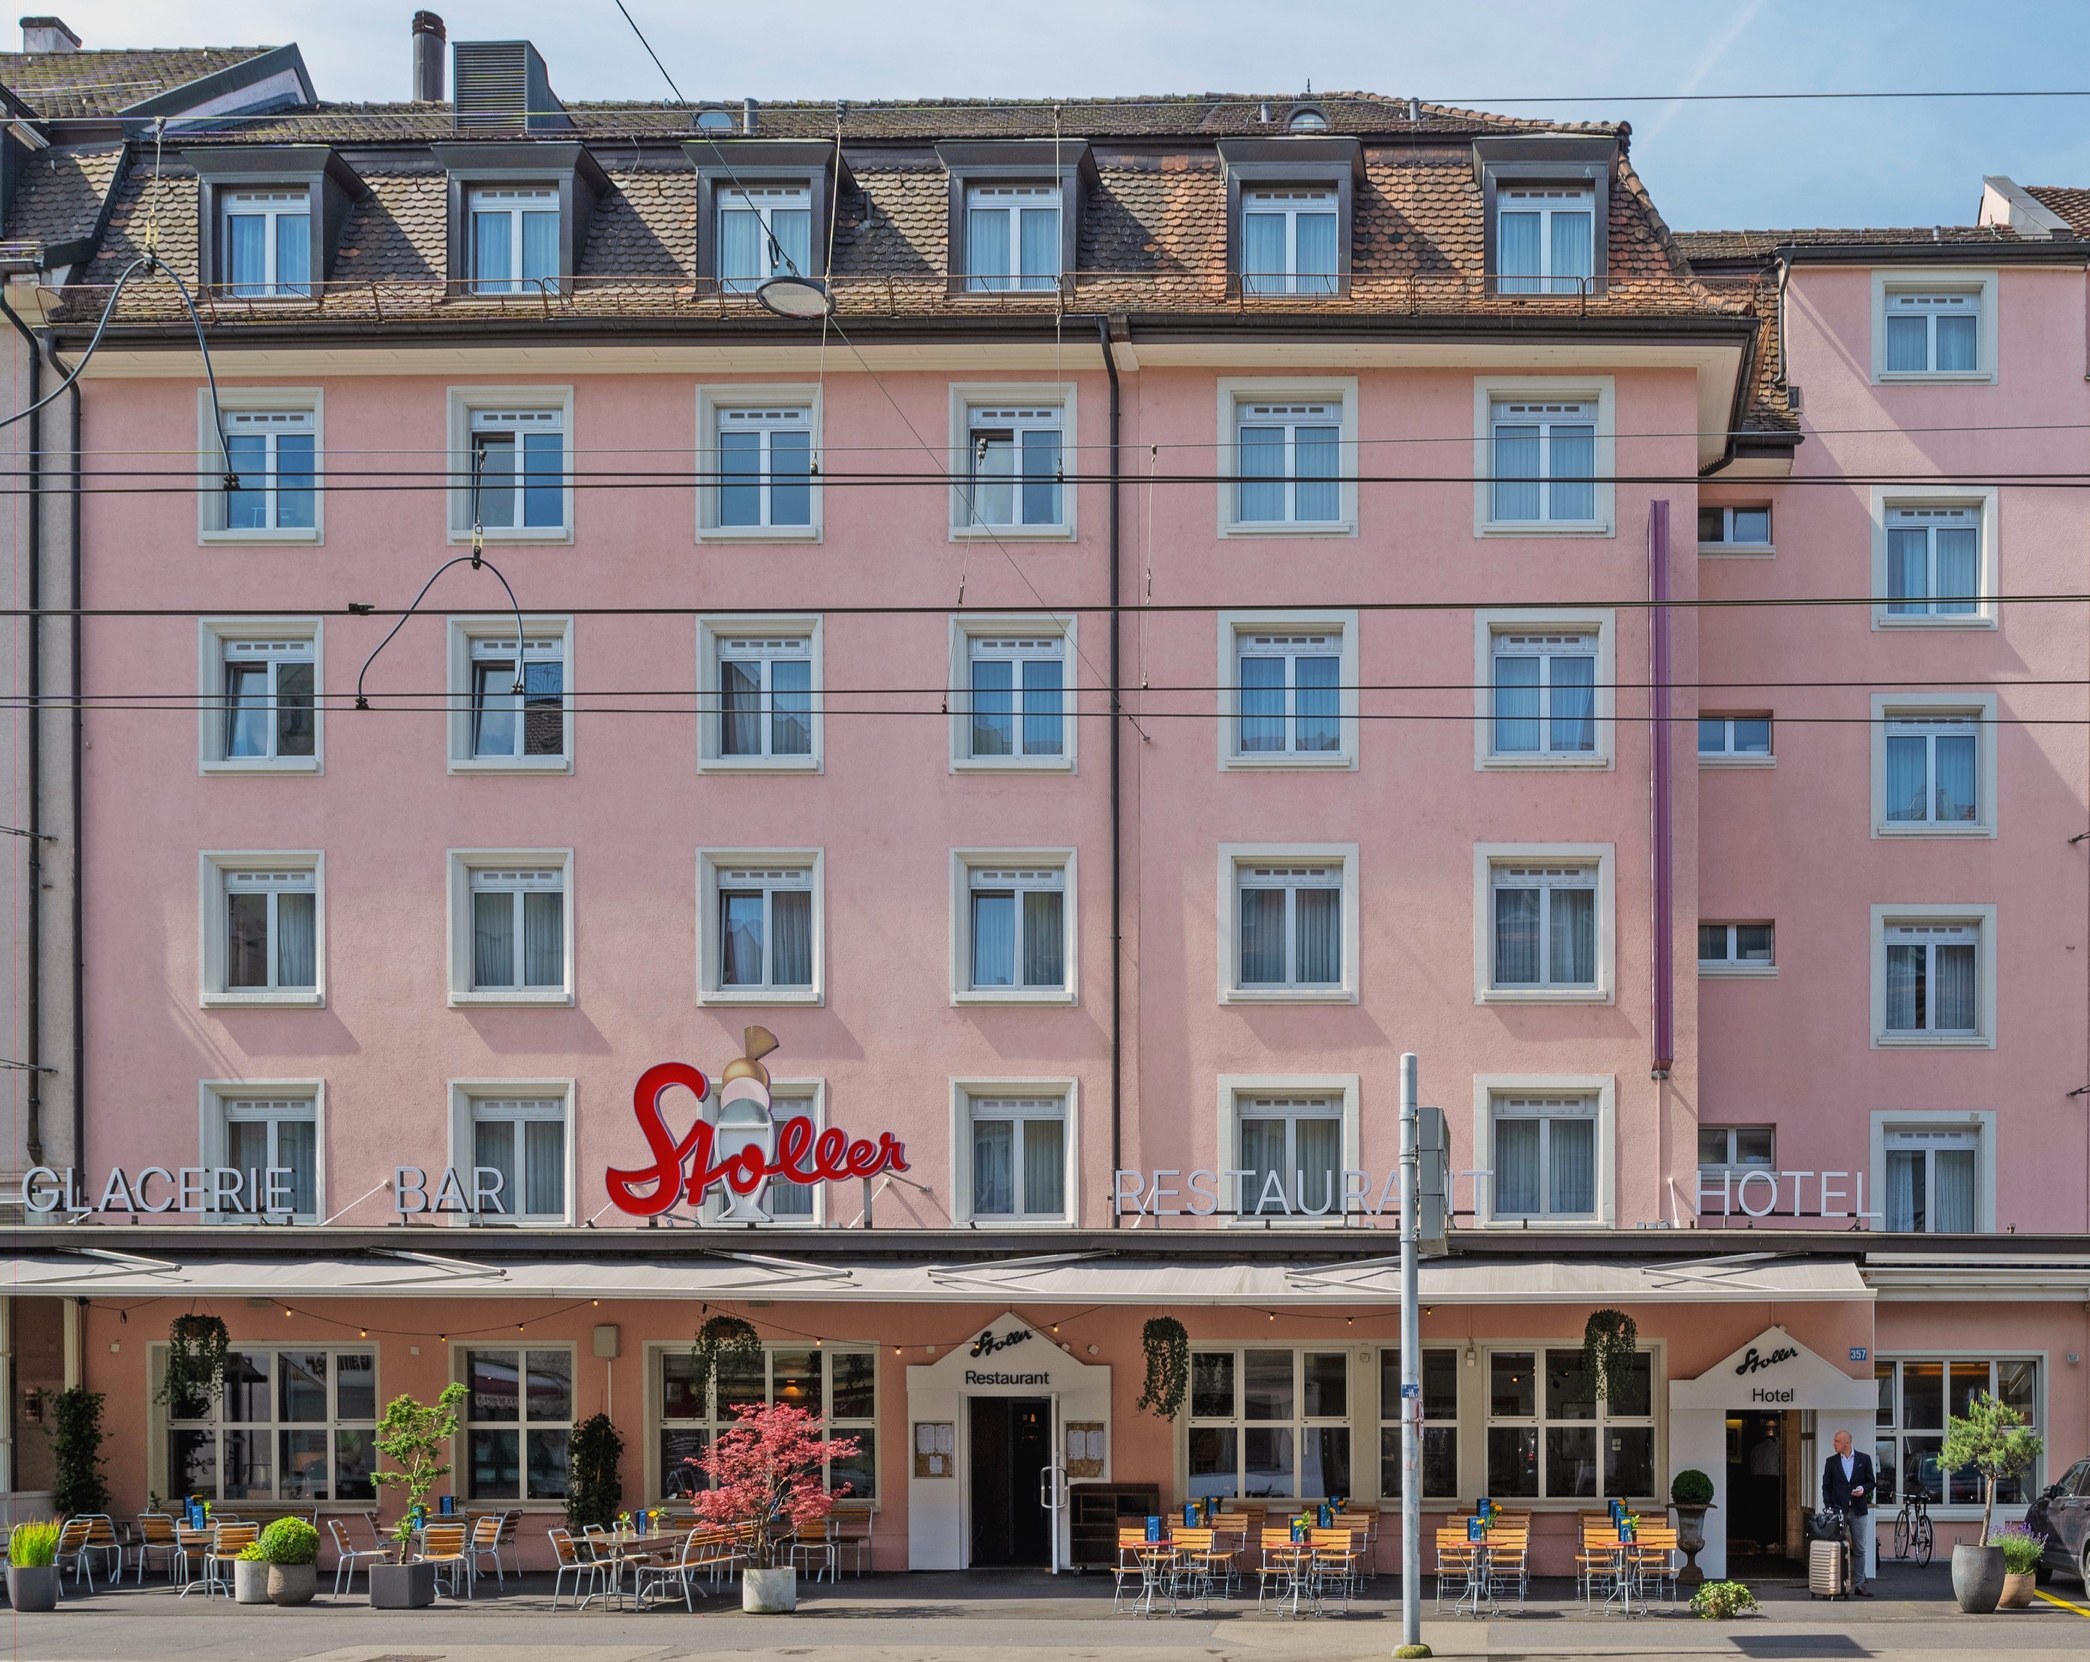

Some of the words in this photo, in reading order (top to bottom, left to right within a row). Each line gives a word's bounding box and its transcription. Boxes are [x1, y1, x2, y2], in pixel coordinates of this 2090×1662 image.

[605, 1062, 911, 1217] Stoller
[21, 1166, 295, 1213] GLACERIE
[394, 1166, 506, 1213] BAR
[1696, 1170, 1882, 1217] HOTEL
[970, 1329, 1032, 1358] Stoller
[1850, 1350, 1866, 1360] 357
[1735, 1346, 1798, 1376] Stoller
[965, 1370, 1050, 1385] Restaurant
[1752, 1388, 1794, 1402] Hotel
